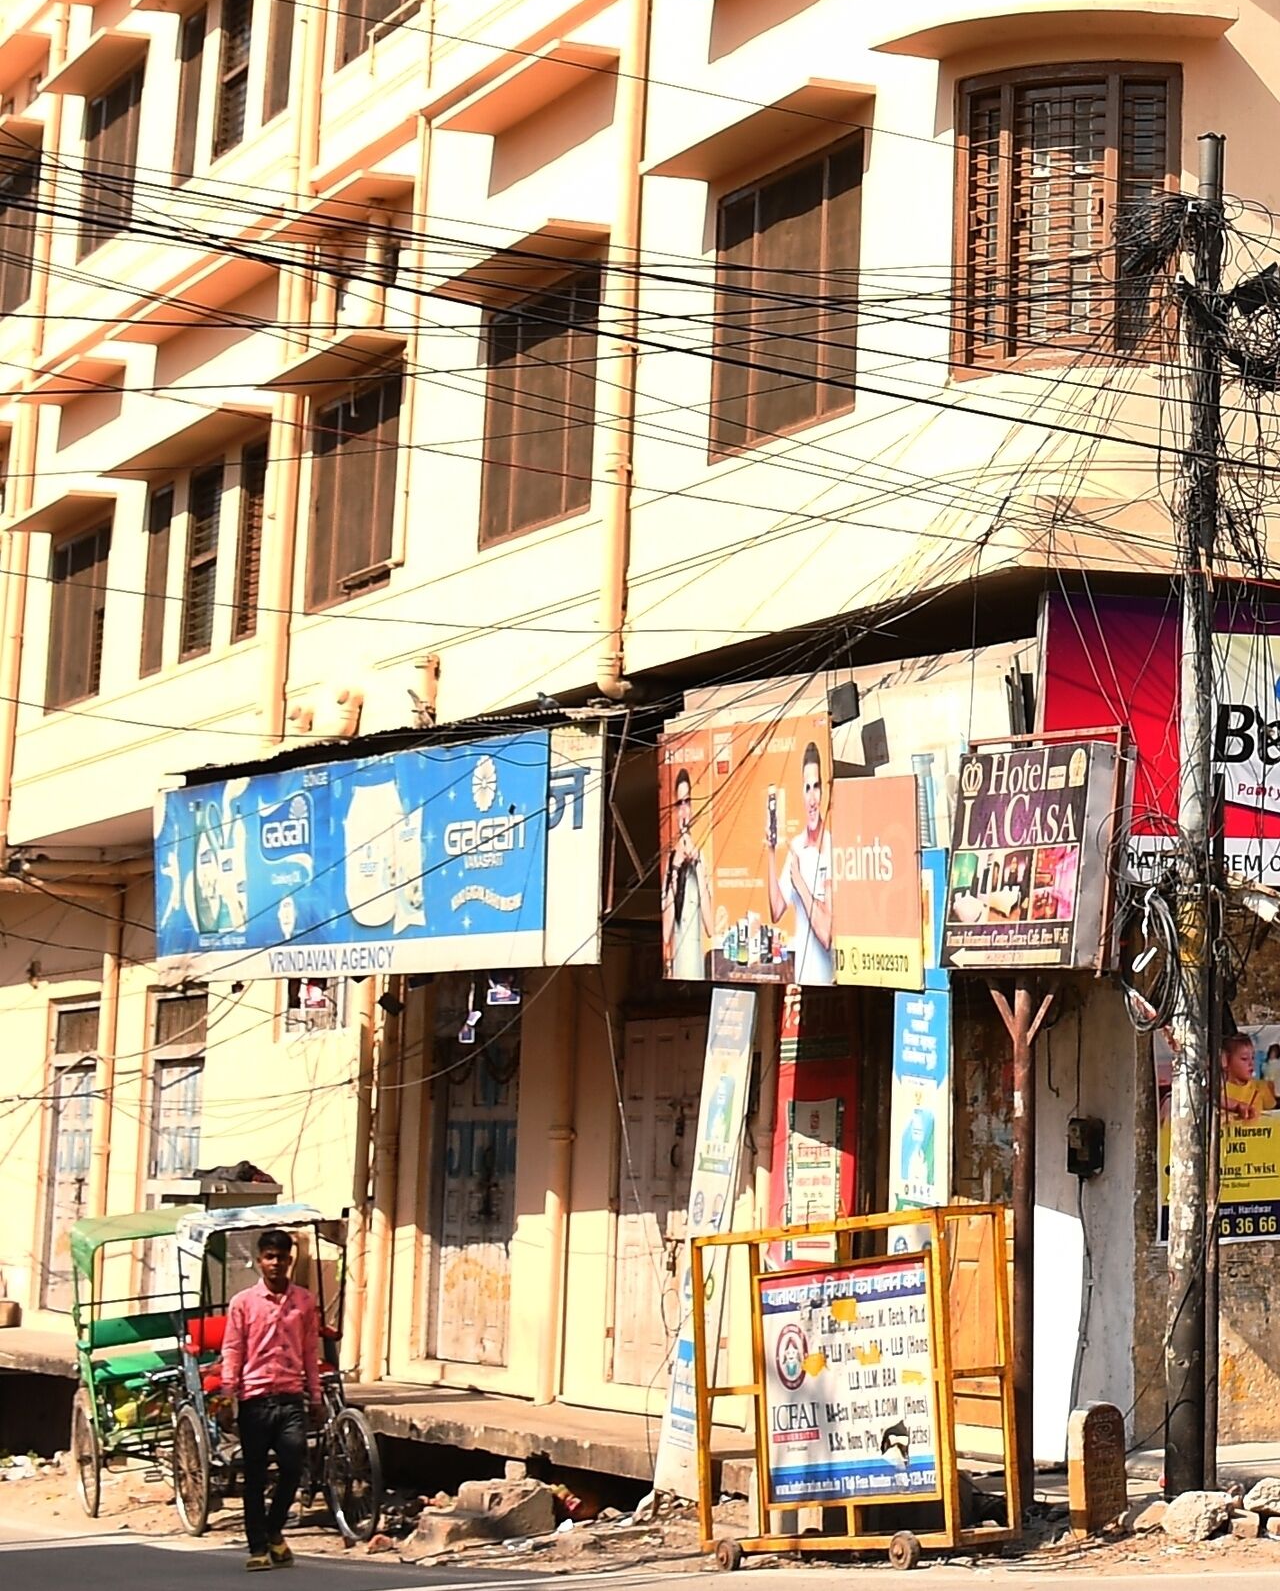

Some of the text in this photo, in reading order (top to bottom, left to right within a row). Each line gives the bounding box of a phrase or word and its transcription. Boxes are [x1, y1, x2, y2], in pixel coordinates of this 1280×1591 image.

[987, 748, 1050, 795] Hotel
[833, 837, 893, 890] paints
[268, 946, 395, 973] VRINDAVAN AGENCY
[862, 948, 909, 973] 9319029370
[1234, 1126, 1272, 1138] Nursery
[1244, 1162, 1276, 1175] Twist
[1235, 1216, 1254, 1234] 36
[1259, 1215, 1277, 1233] 66
[882, 1368, 897, 1388] BBA
[772, 1402, 819, 1432] ICFAI
